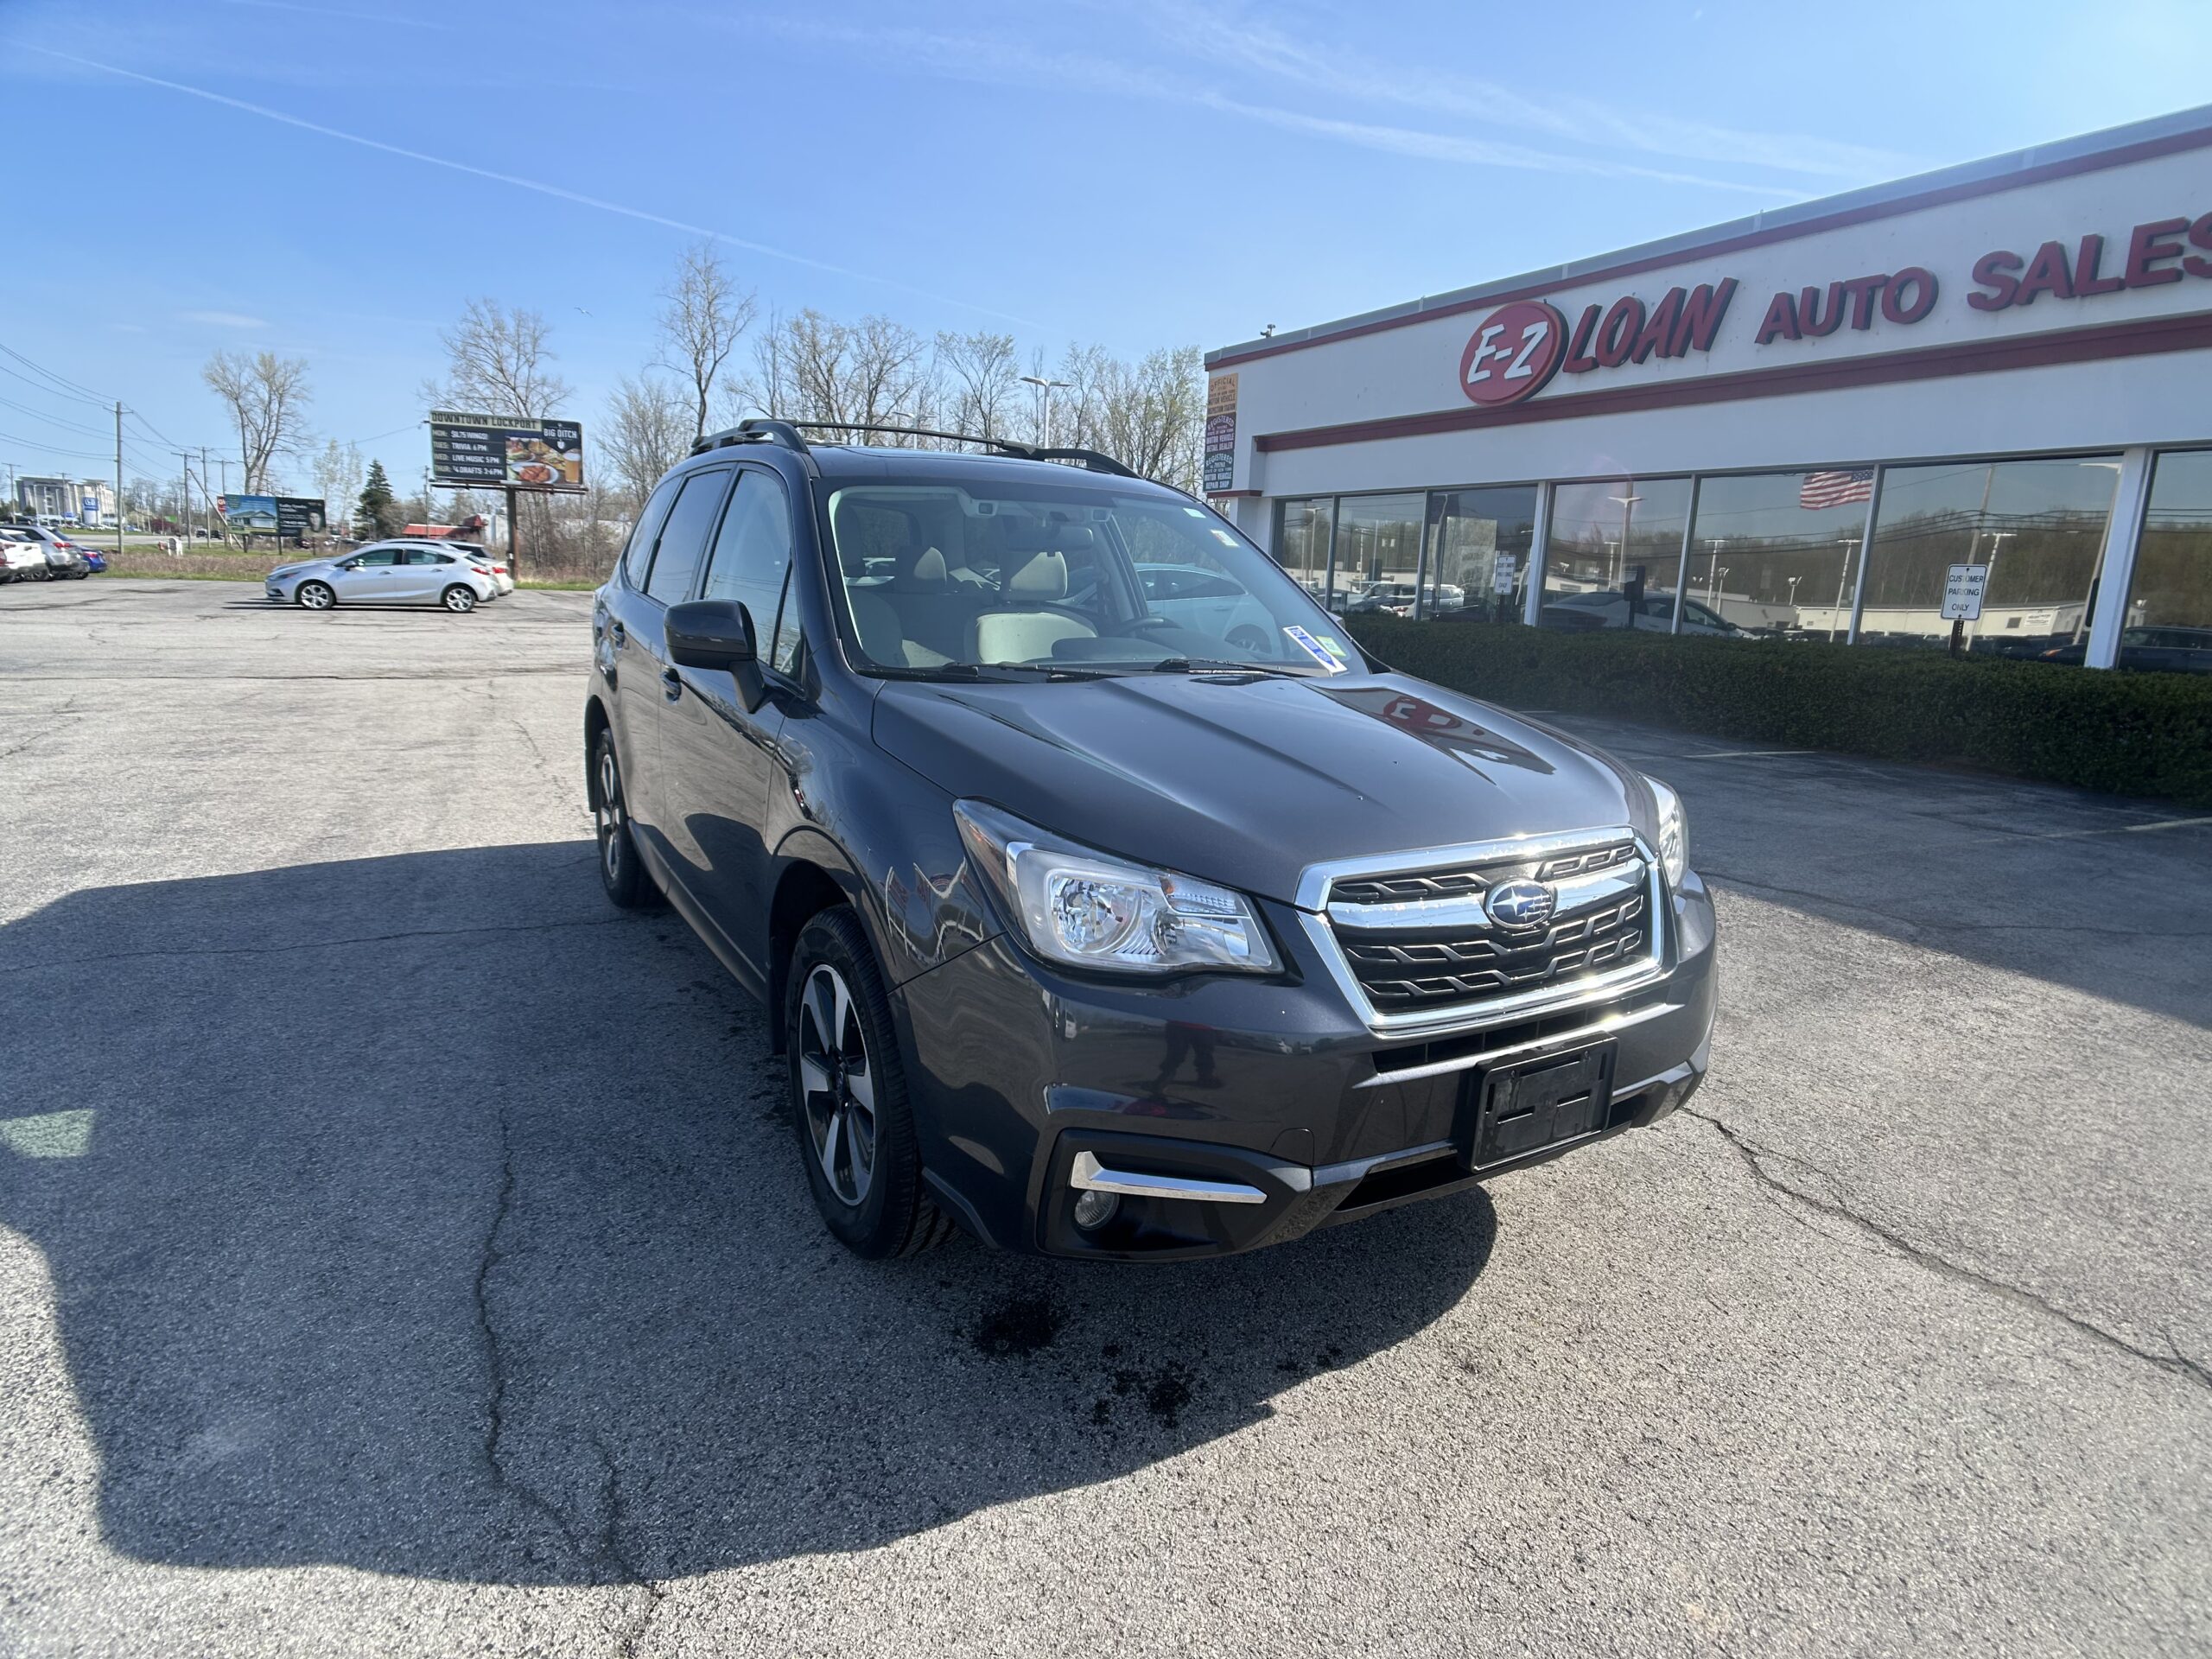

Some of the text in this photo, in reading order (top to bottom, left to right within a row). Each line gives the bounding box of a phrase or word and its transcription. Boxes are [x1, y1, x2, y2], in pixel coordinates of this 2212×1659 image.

[1467, 321, 1548, 385] E-Z
[1562, 276, 1738, 374] LOAN
[1755, 266, 1939, 345] AUTO
[432, 412, 537, 429] DOWNTOWN LOCKPORT
[1207, 415, 1234, 430] REGISTERED
[543, 428, 577, 439] BIG DITCH
[465, 455, 485, 464] MUSIC
[1205, 453, 1232, 467] REGISTERED
[1217, 471, 1232, 480] VEHICLE
[1205, 481, 1218, 490] REPAIR
